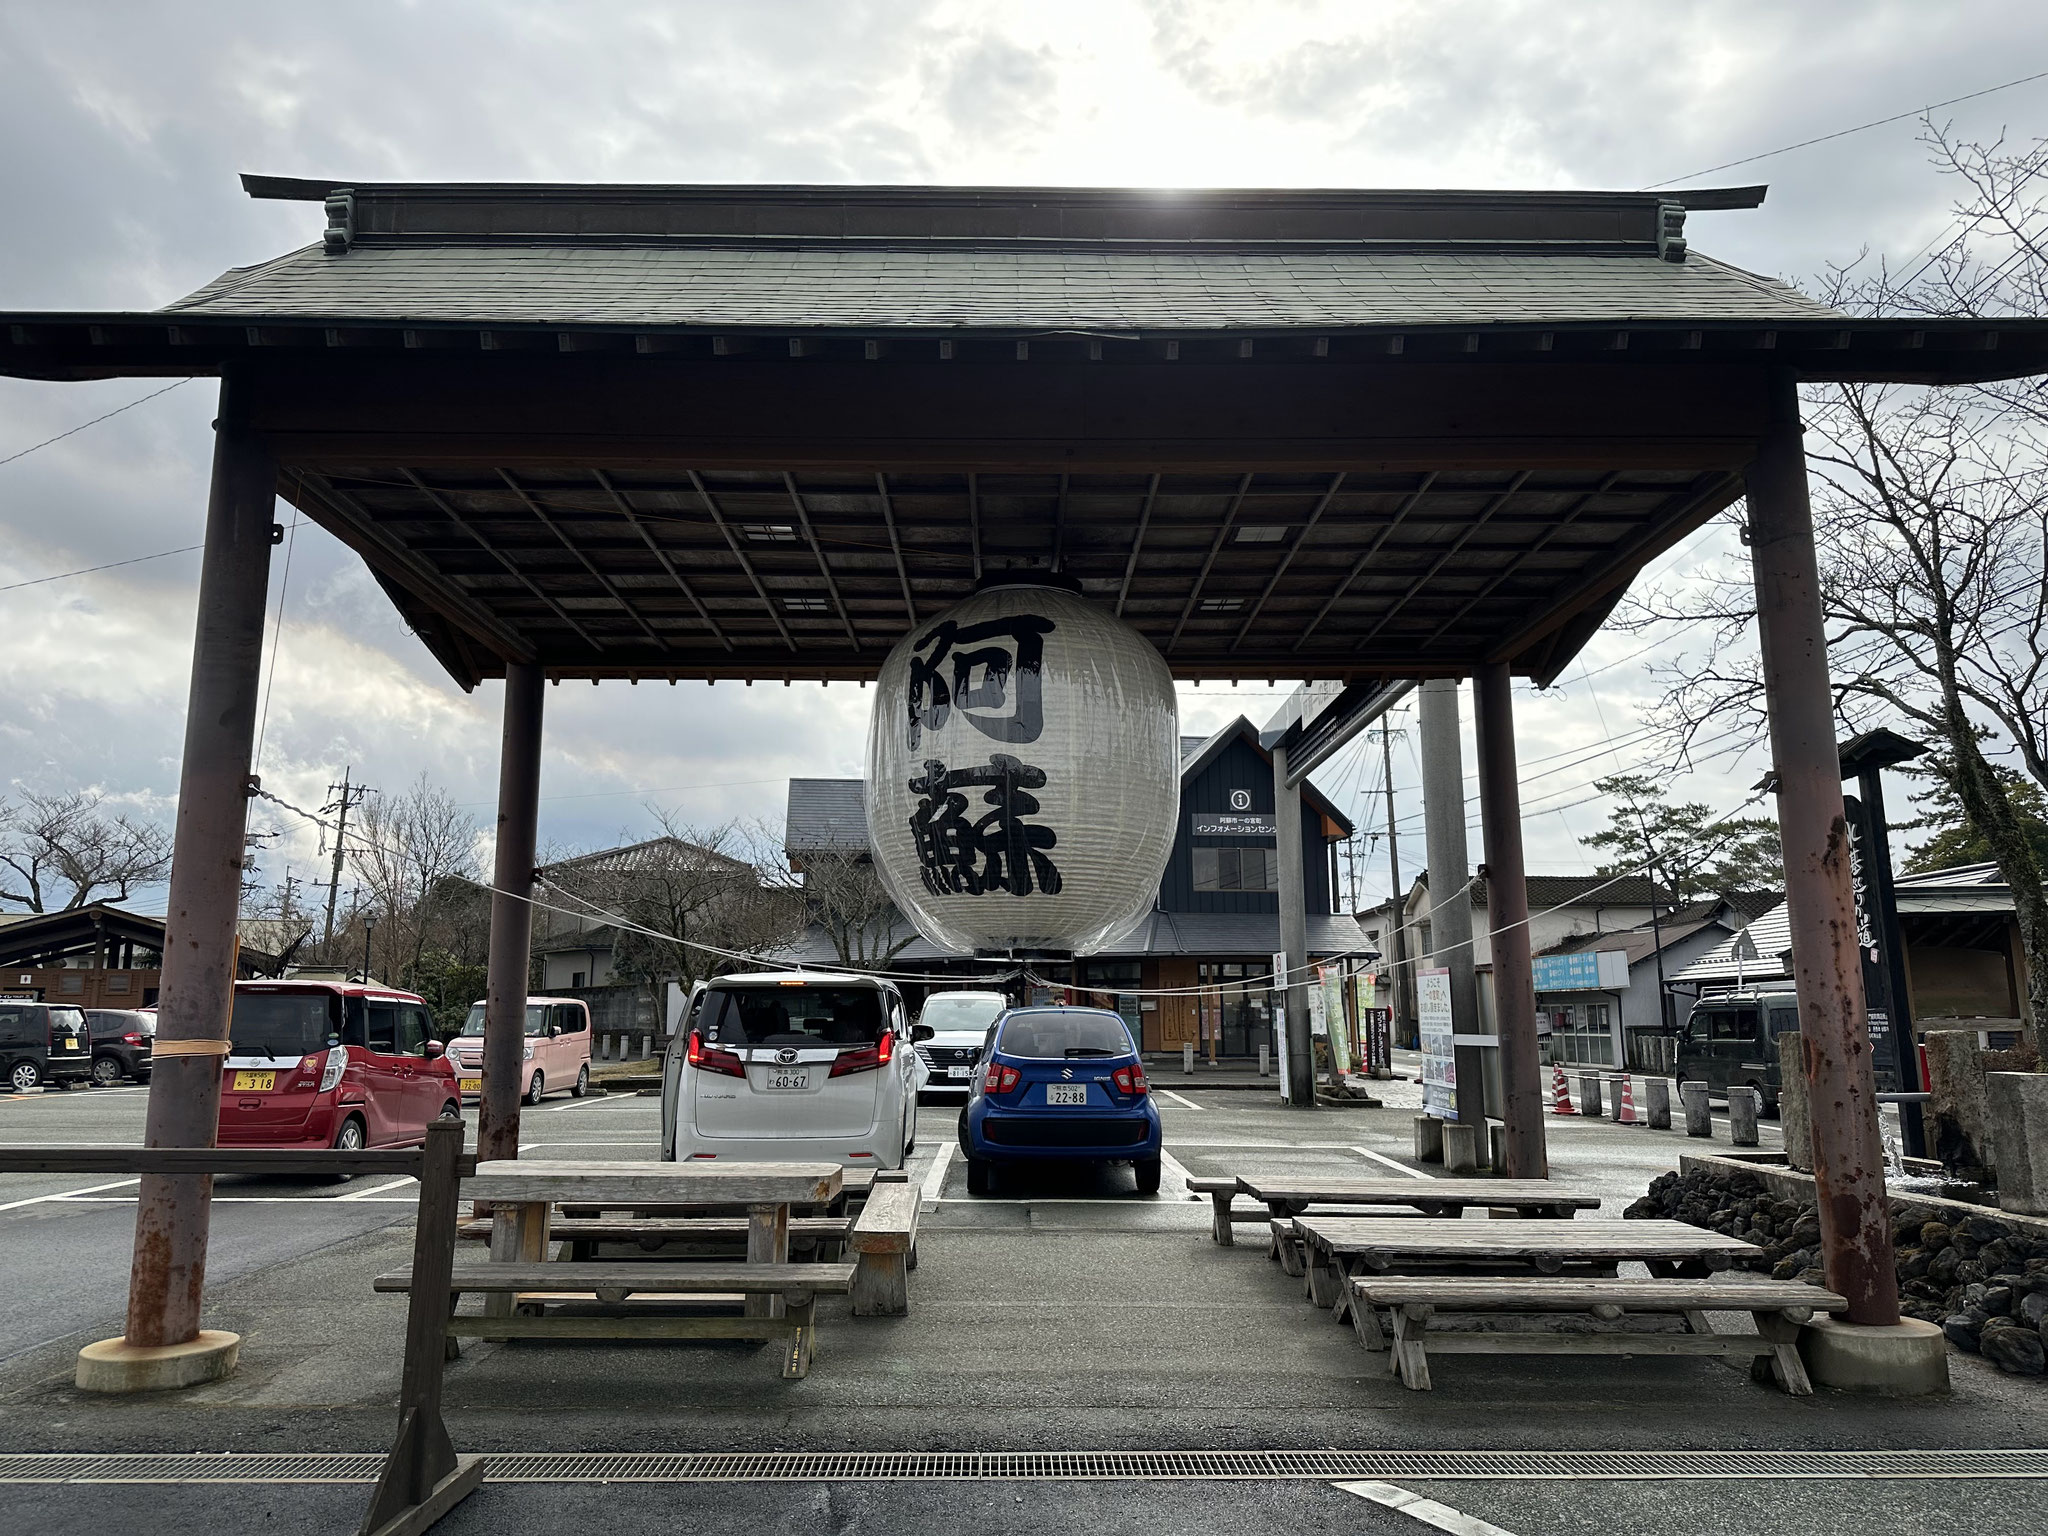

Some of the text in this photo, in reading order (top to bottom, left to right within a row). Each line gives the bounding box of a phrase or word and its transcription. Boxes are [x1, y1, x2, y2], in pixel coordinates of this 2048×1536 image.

[907, 614, 1063, 896] 阿蘇
[1220, 817, 1262, 825] 阿蘇市一の宮町
[775, 1076, 806, 1087] 60-67
[1055, 1092, 1085, 1103] 22-88
